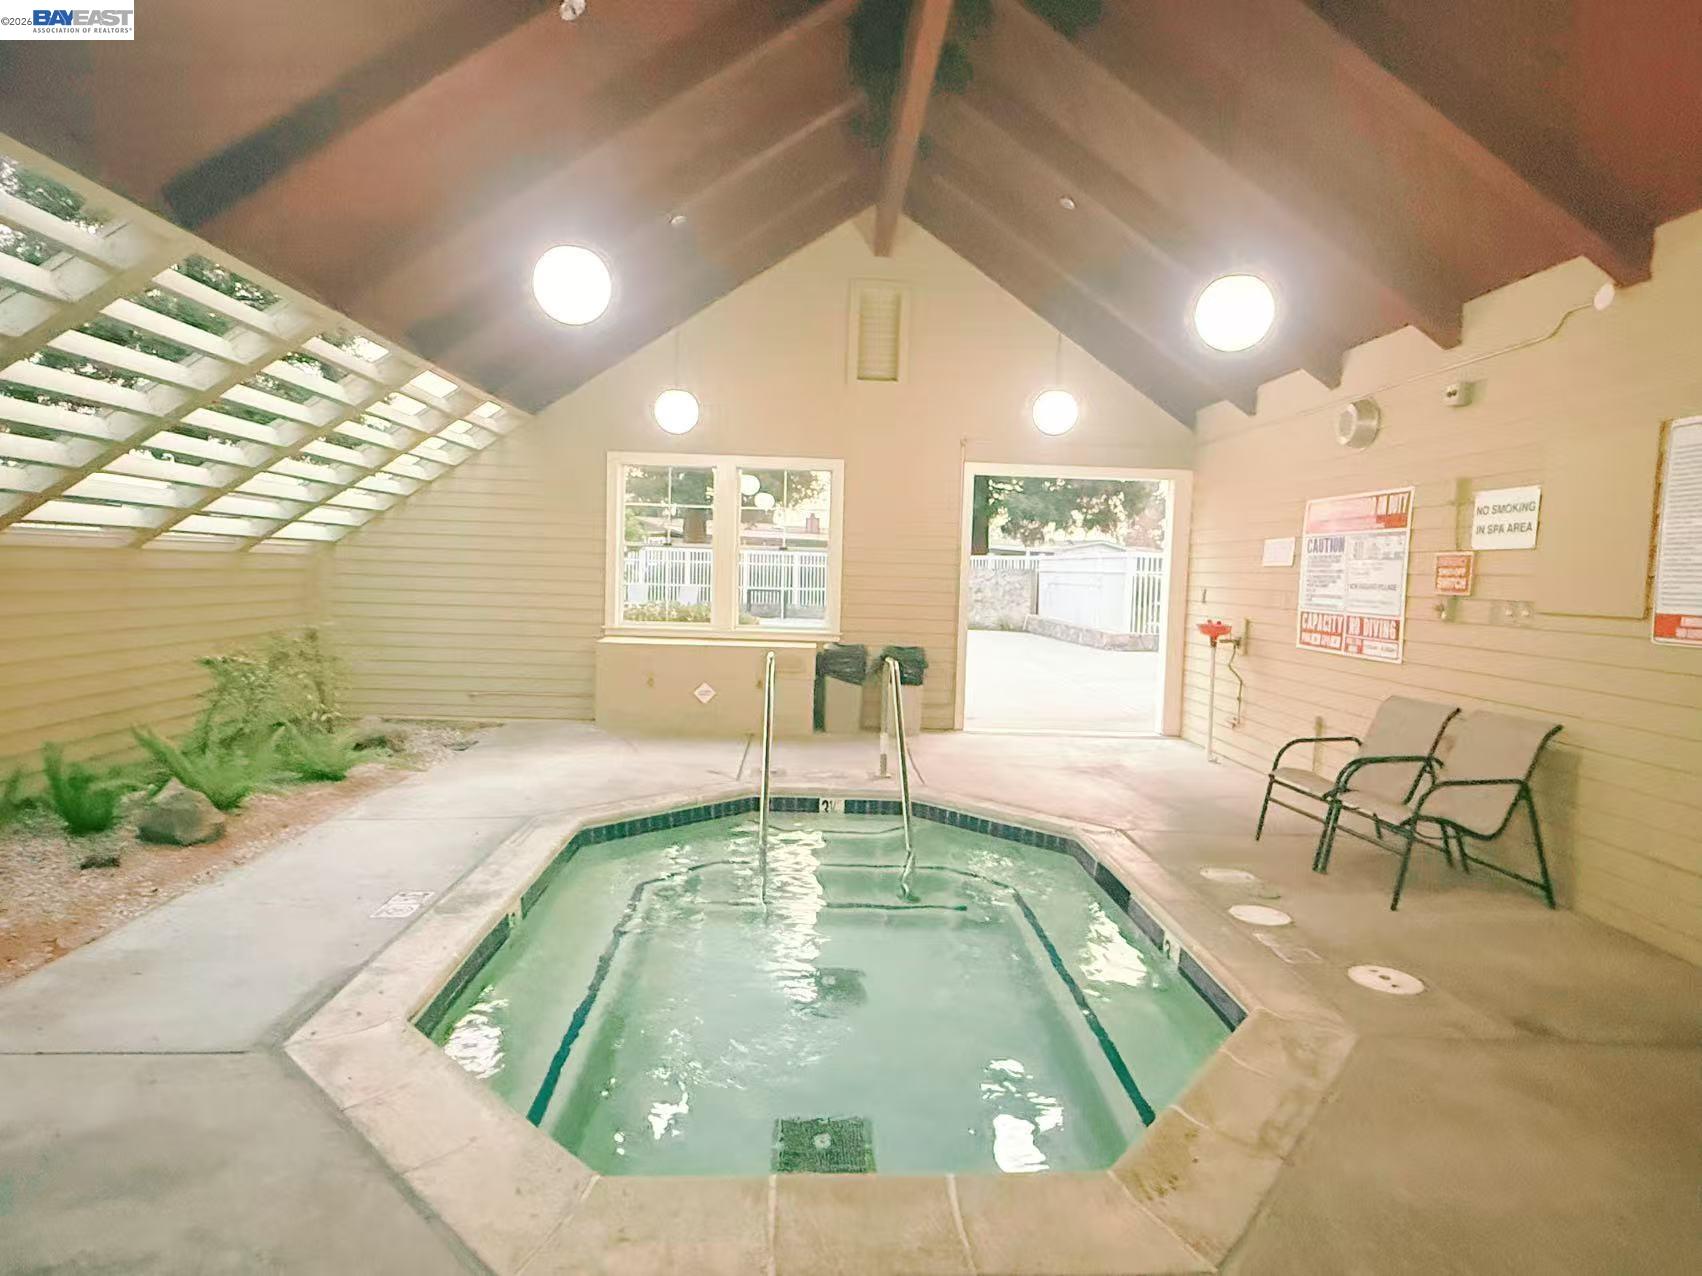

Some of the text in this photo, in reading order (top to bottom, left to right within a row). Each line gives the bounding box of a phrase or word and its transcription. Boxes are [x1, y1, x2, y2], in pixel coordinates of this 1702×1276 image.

[1476, 500, 1537, 516] NO SMOKING
[1475, 521, 1533, 535] IN SPA AREA
[1307, 536, 1345, 554] CAUTION
[1302, 612, 1344, 634] CAPACITY
[1348, 616, 1397, 640] NO DIVING
